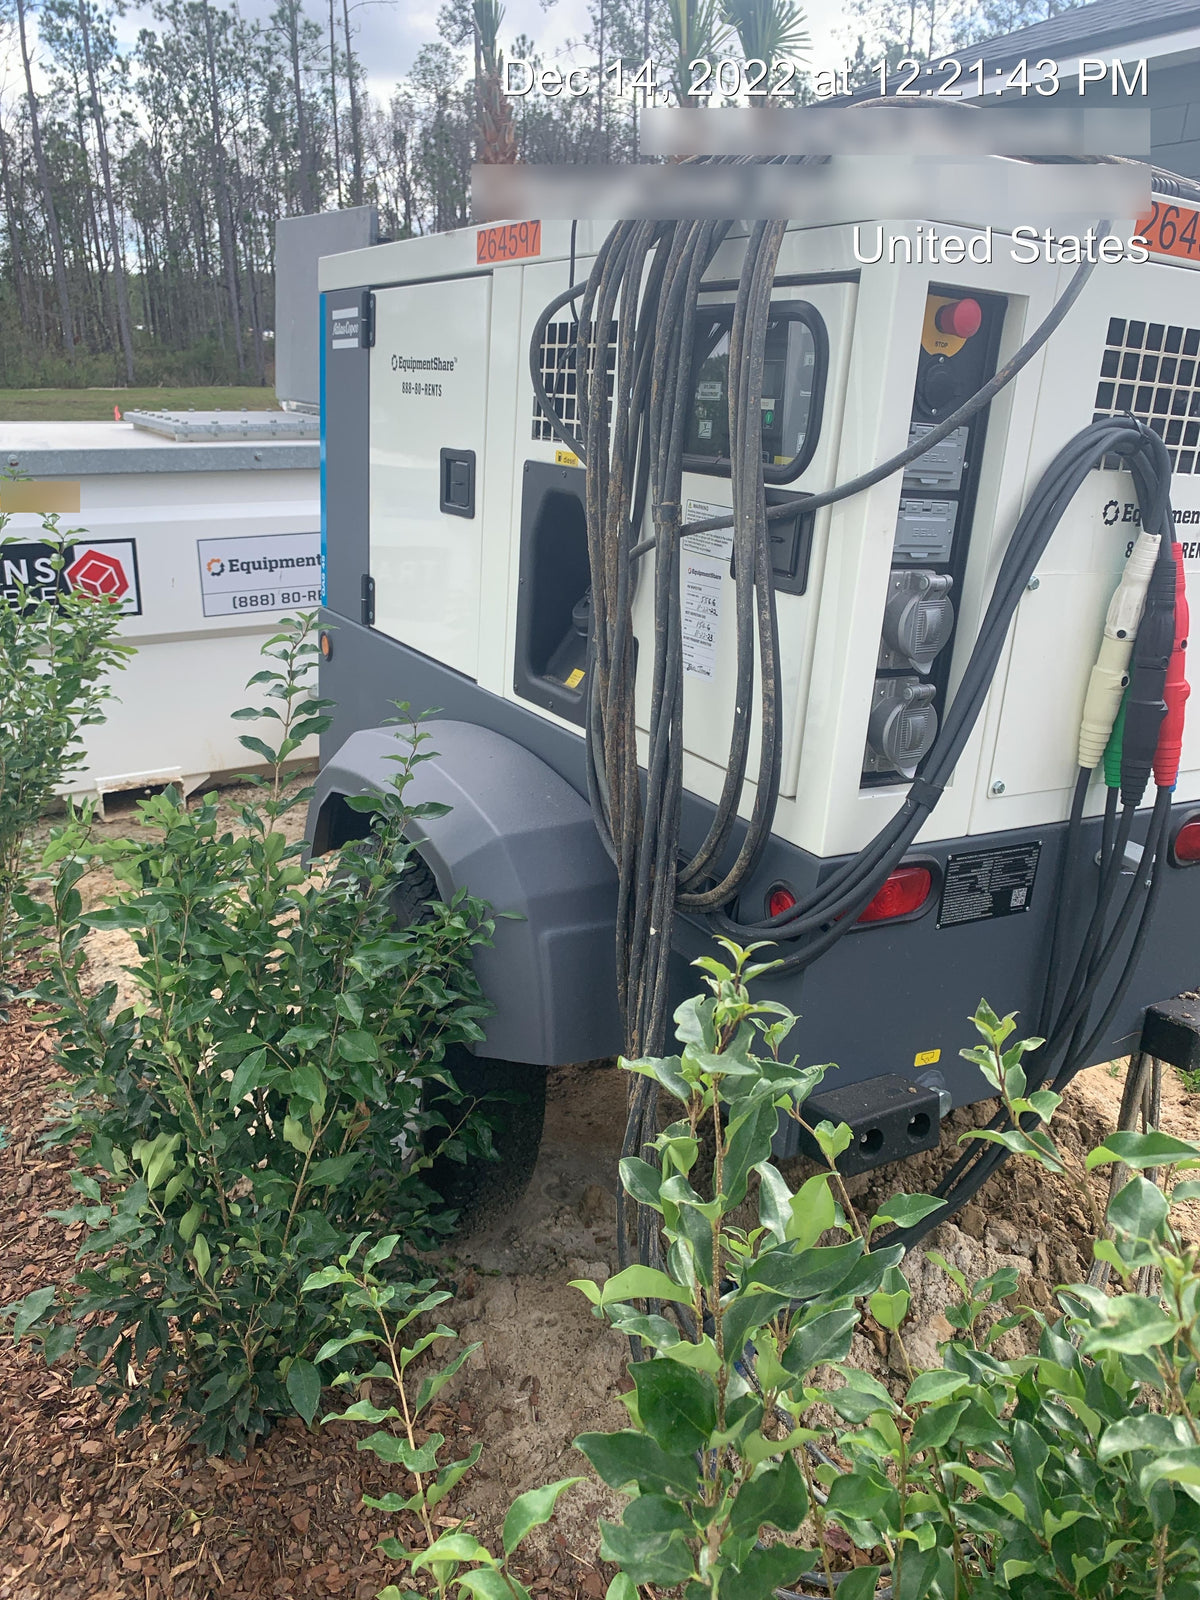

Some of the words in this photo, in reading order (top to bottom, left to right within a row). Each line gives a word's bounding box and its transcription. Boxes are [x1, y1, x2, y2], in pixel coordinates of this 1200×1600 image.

[1134, 200, 1200, 255] 264
[478, 219, 540, 260] 264597
[398, 355, 455, 373] EquipmentShare
[401, 382, 443, 397] 888-80-RENTS
[0, 557, 56, 586] NS
[232, 593, 275, 610] (888)
